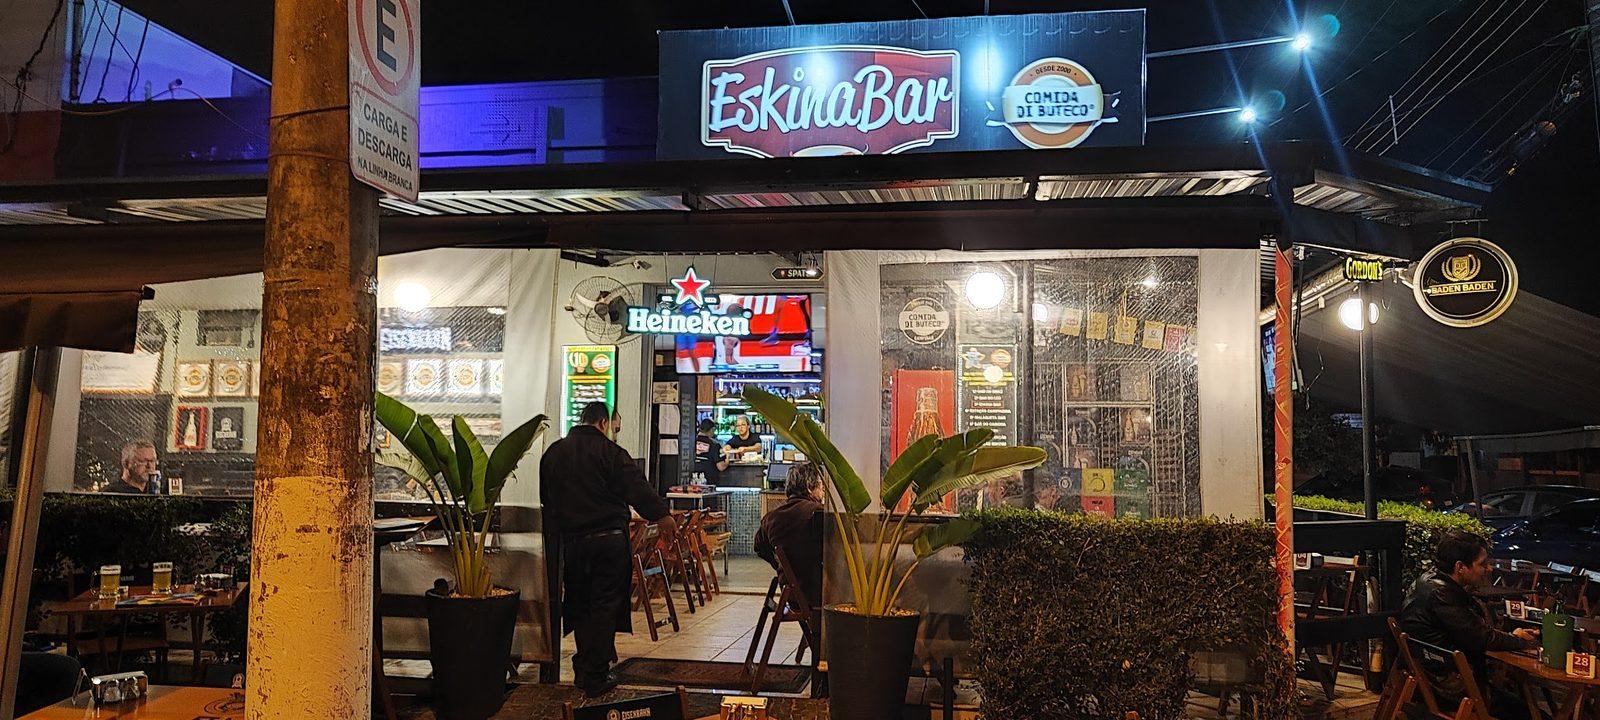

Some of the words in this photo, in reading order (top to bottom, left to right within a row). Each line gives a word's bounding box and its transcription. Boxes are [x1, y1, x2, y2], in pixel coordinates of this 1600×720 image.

[376, 0, 397, 72] E
[1035, 64, 1056, 75] DESDE
[1056, 65, 1072, 74] 2000
[1025, 91, 1079, 104] COMIDA
[1017, 105, 1033, 118] DI
[363, 103, 400, 139] CARGA
[401, 125, 408, 143] E
[357, 127, 412, 171] DESCARGA
[357, 156, 368, 172] NA
[368, 161, 388, 180] LINHA
[388, 171, 413, 192] BRANCA
[1346, 256, 1383, 280] GORDON'S
[1431, 284, 1461, 294] BADEN
[1462, 282, 1494, 292] BADEN
[627, 307, 750, 336] Heineken
[908, 313, 937, 321] COMIDA
[904, 320, 914, 328] DI
[1574, 656, 1589, 667] 28
